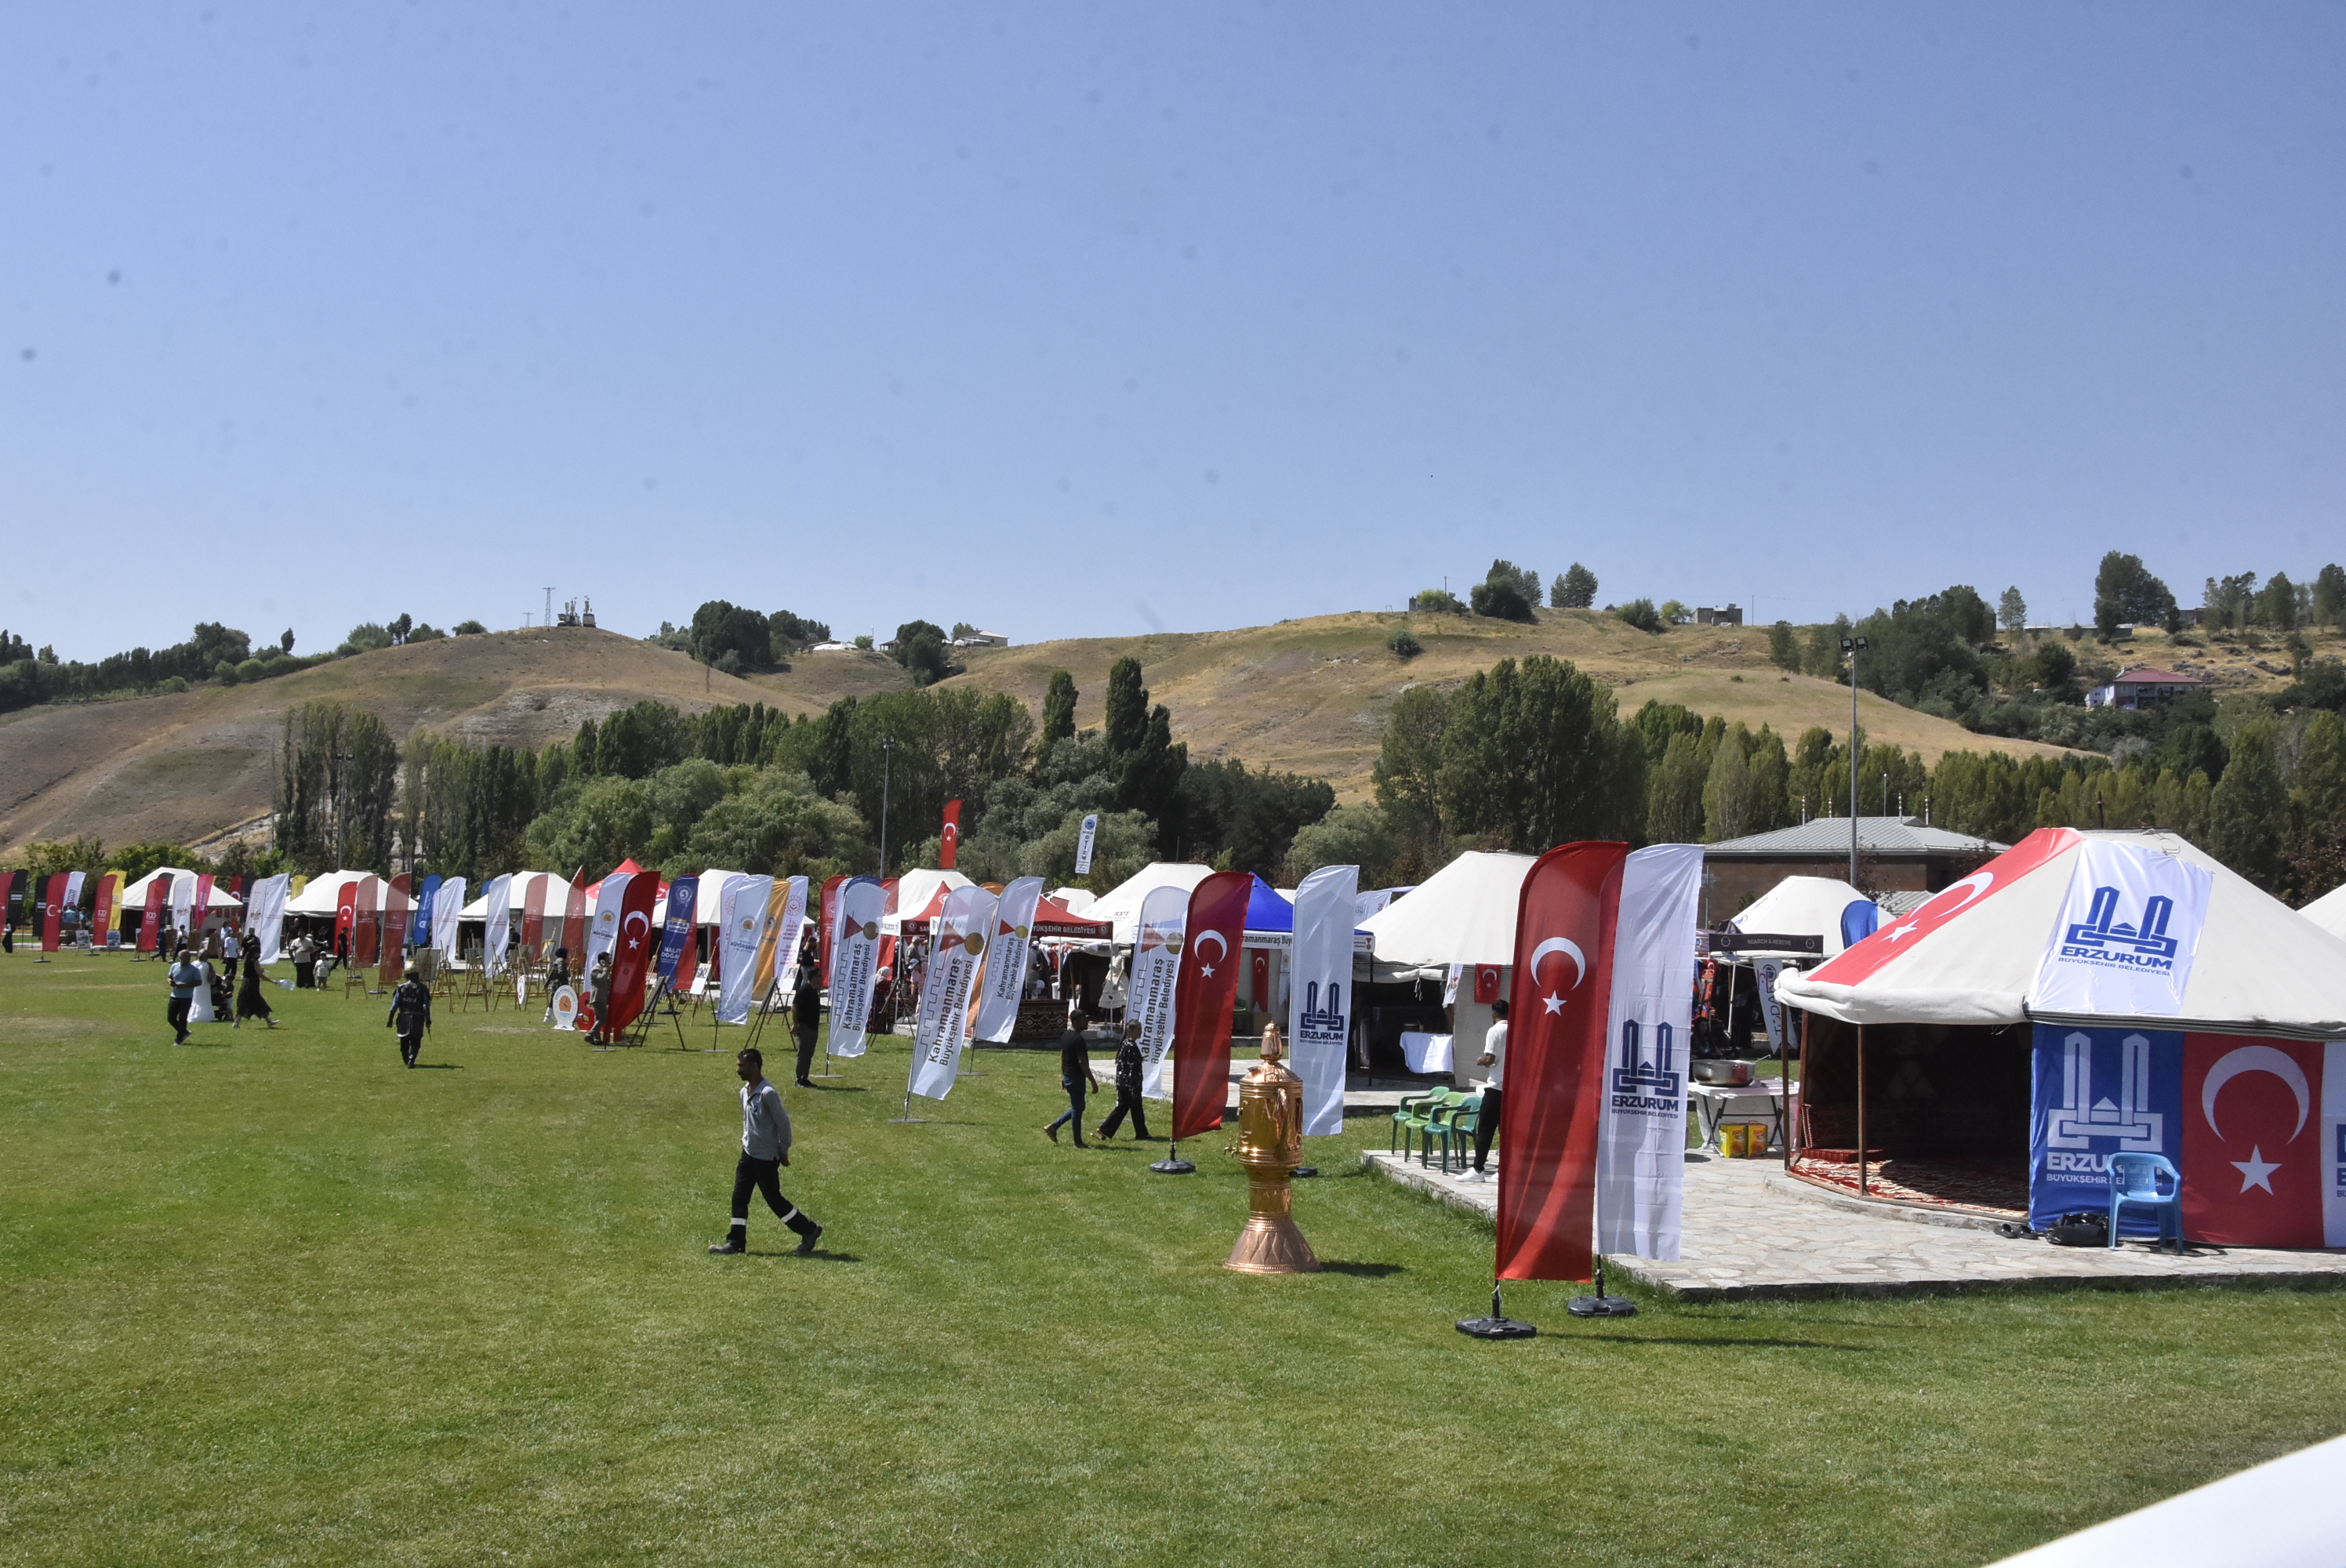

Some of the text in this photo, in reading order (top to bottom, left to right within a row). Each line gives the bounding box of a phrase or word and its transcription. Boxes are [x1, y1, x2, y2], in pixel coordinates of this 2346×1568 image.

[1032, 924, 1096, 935] YÜKŞEHİR BELEDİYESİ
[1242, 935, 1281, 946] ramanmaraş
[997, 937, 1015, 998] Kahramanmaraş
[1005, 938, 1024, 1000] Büyükşehir Belediyesi
[2057, 956, 2170, 976] BÜYÜKŞEHİR BELEDİYESİ
[2060, 946, 2174, 971] ERZURUM
[842, 943, 862, 1030] Kahramanmaraş
[852, 944, 870, 1032] Büyükşehir Belediyesi
[928, 957, 963, 1063] Kahramanmaraş
[939, 960, 974, 1066] Büyükşehir Belediyesi
[1150, 959, 1175, 1065] Büyükşehir Belediyesi
[1300, 1030, 1343, 1040] ERZURUM
[1611, 1094, 1679, 1112] ERZURUM
[2046, 1173, 2108, 1185] BÜYÜKŞEHİR
